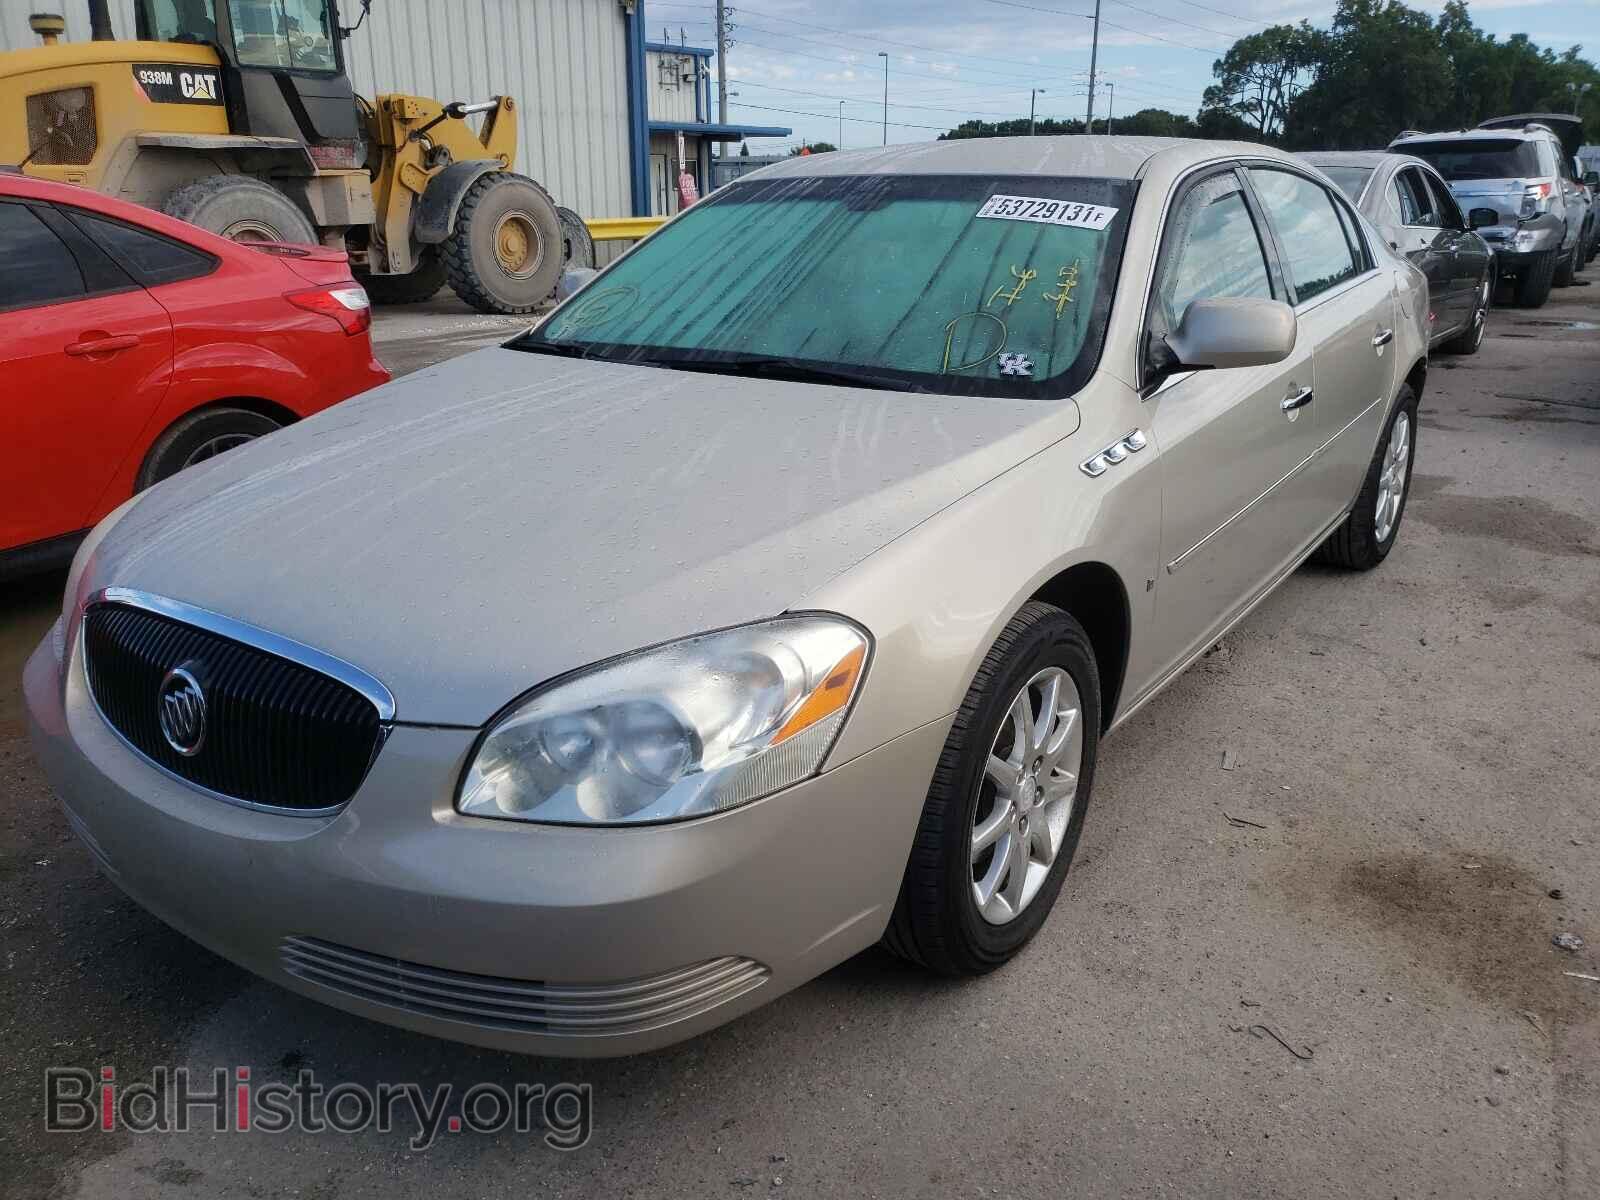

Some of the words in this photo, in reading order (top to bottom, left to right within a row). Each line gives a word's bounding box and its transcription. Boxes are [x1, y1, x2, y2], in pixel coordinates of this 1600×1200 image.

[140, 71, 173, 85] 938M
[180, 73, 216, 99] CAT
[995, 199, 1095, 222] 53729131
